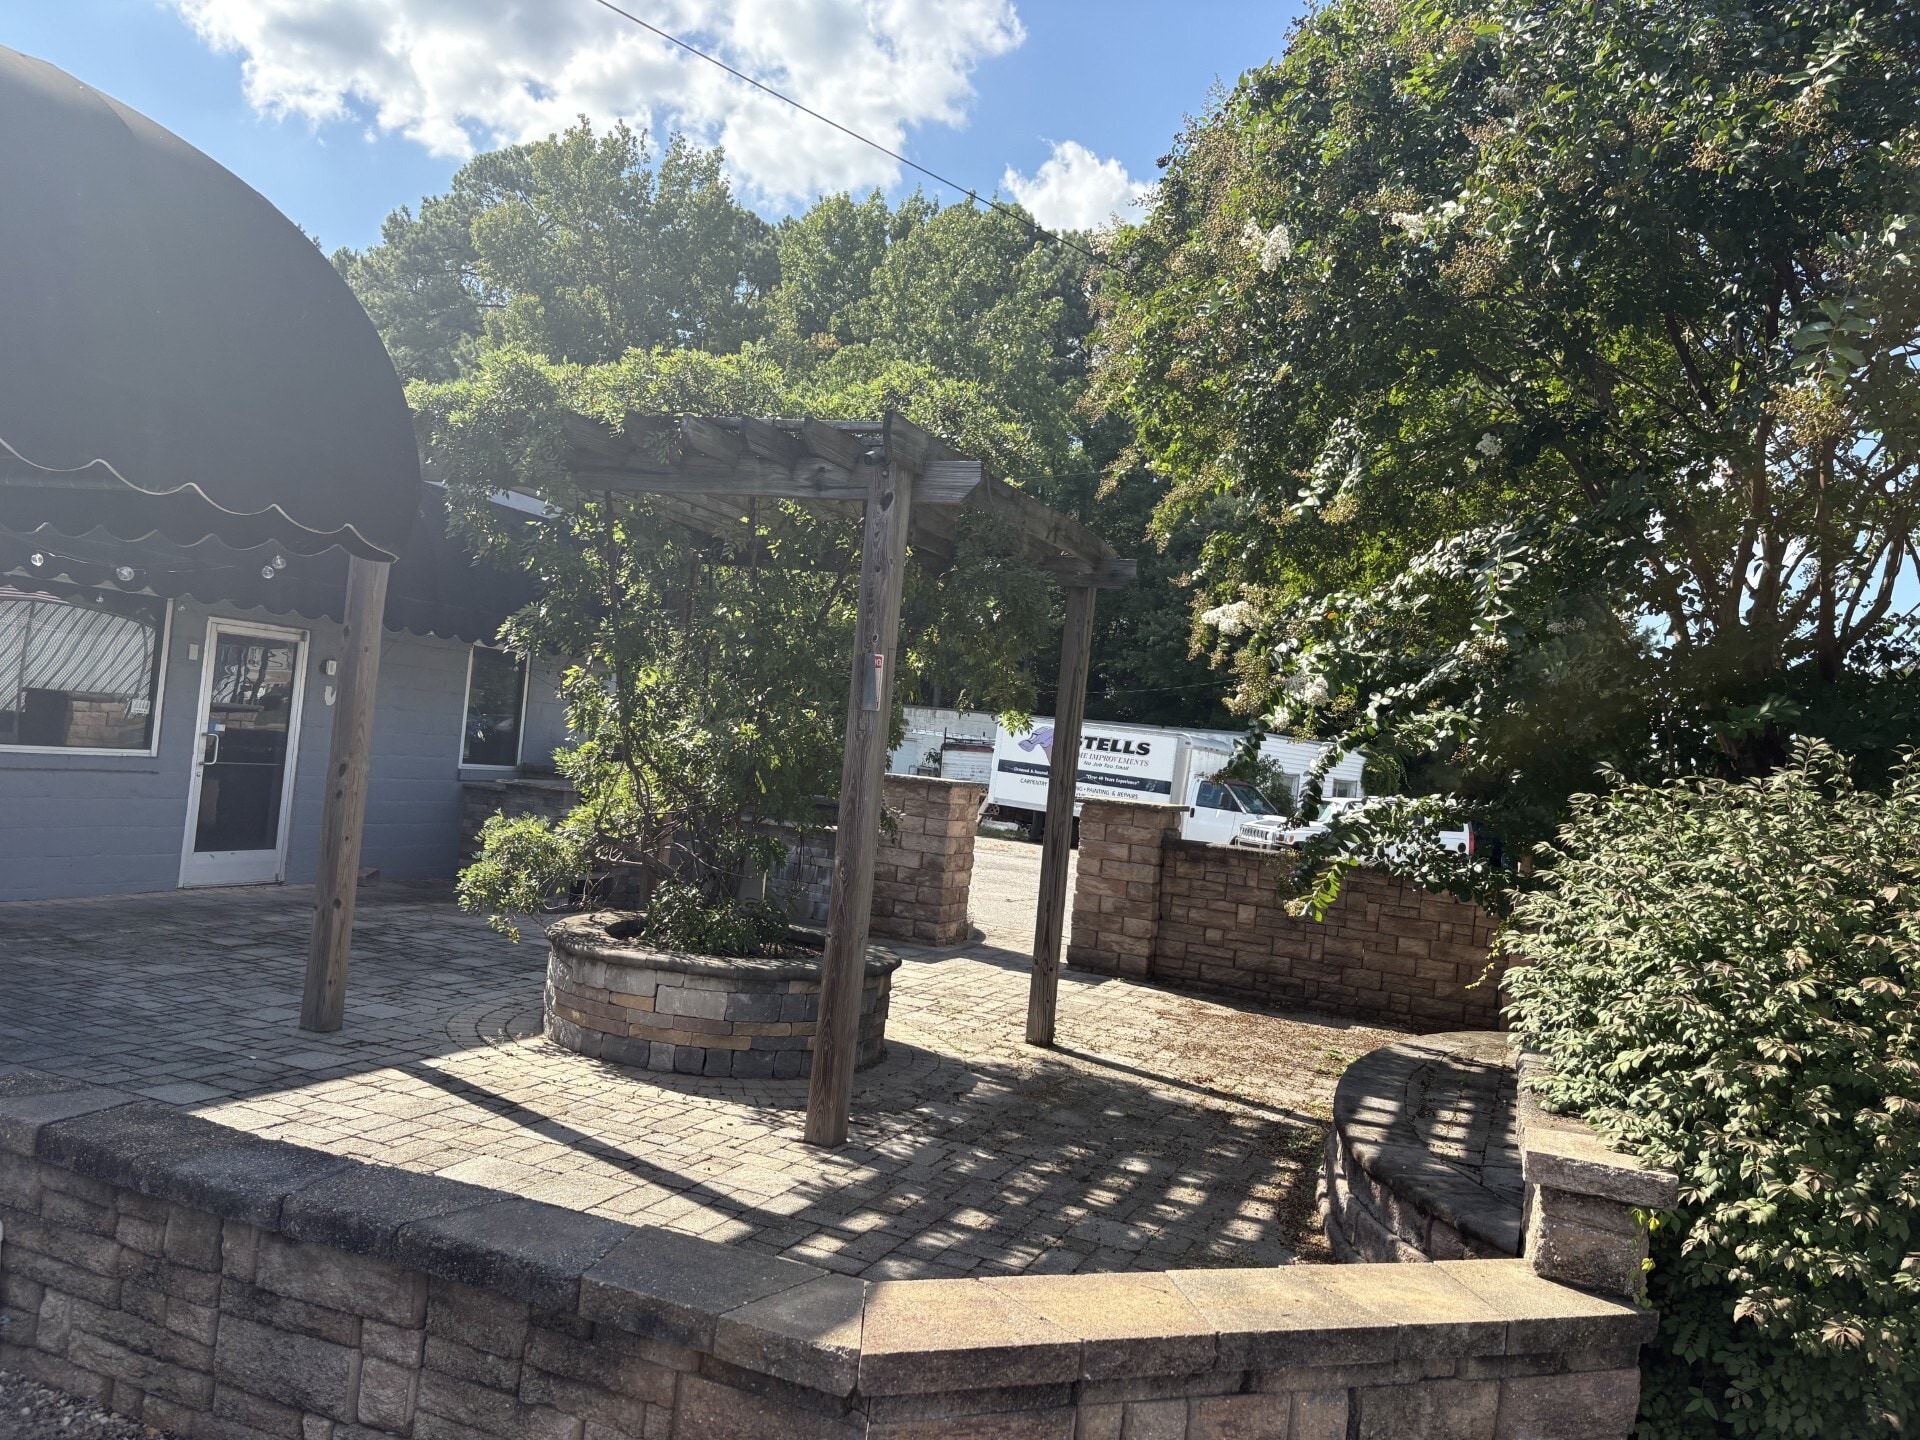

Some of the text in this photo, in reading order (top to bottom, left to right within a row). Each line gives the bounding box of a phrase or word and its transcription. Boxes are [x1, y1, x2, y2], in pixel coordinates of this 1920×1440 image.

[1080, 736, 1151, 756] TELLS
[1089, 753, 1149, 767] IMPROVEMENTS
[1020, 778, 1048, 787] CARPENTRY
[1086, 787, 1110, 796] PAINTING
[1117, 791, 1138, 800] REPAIRS
